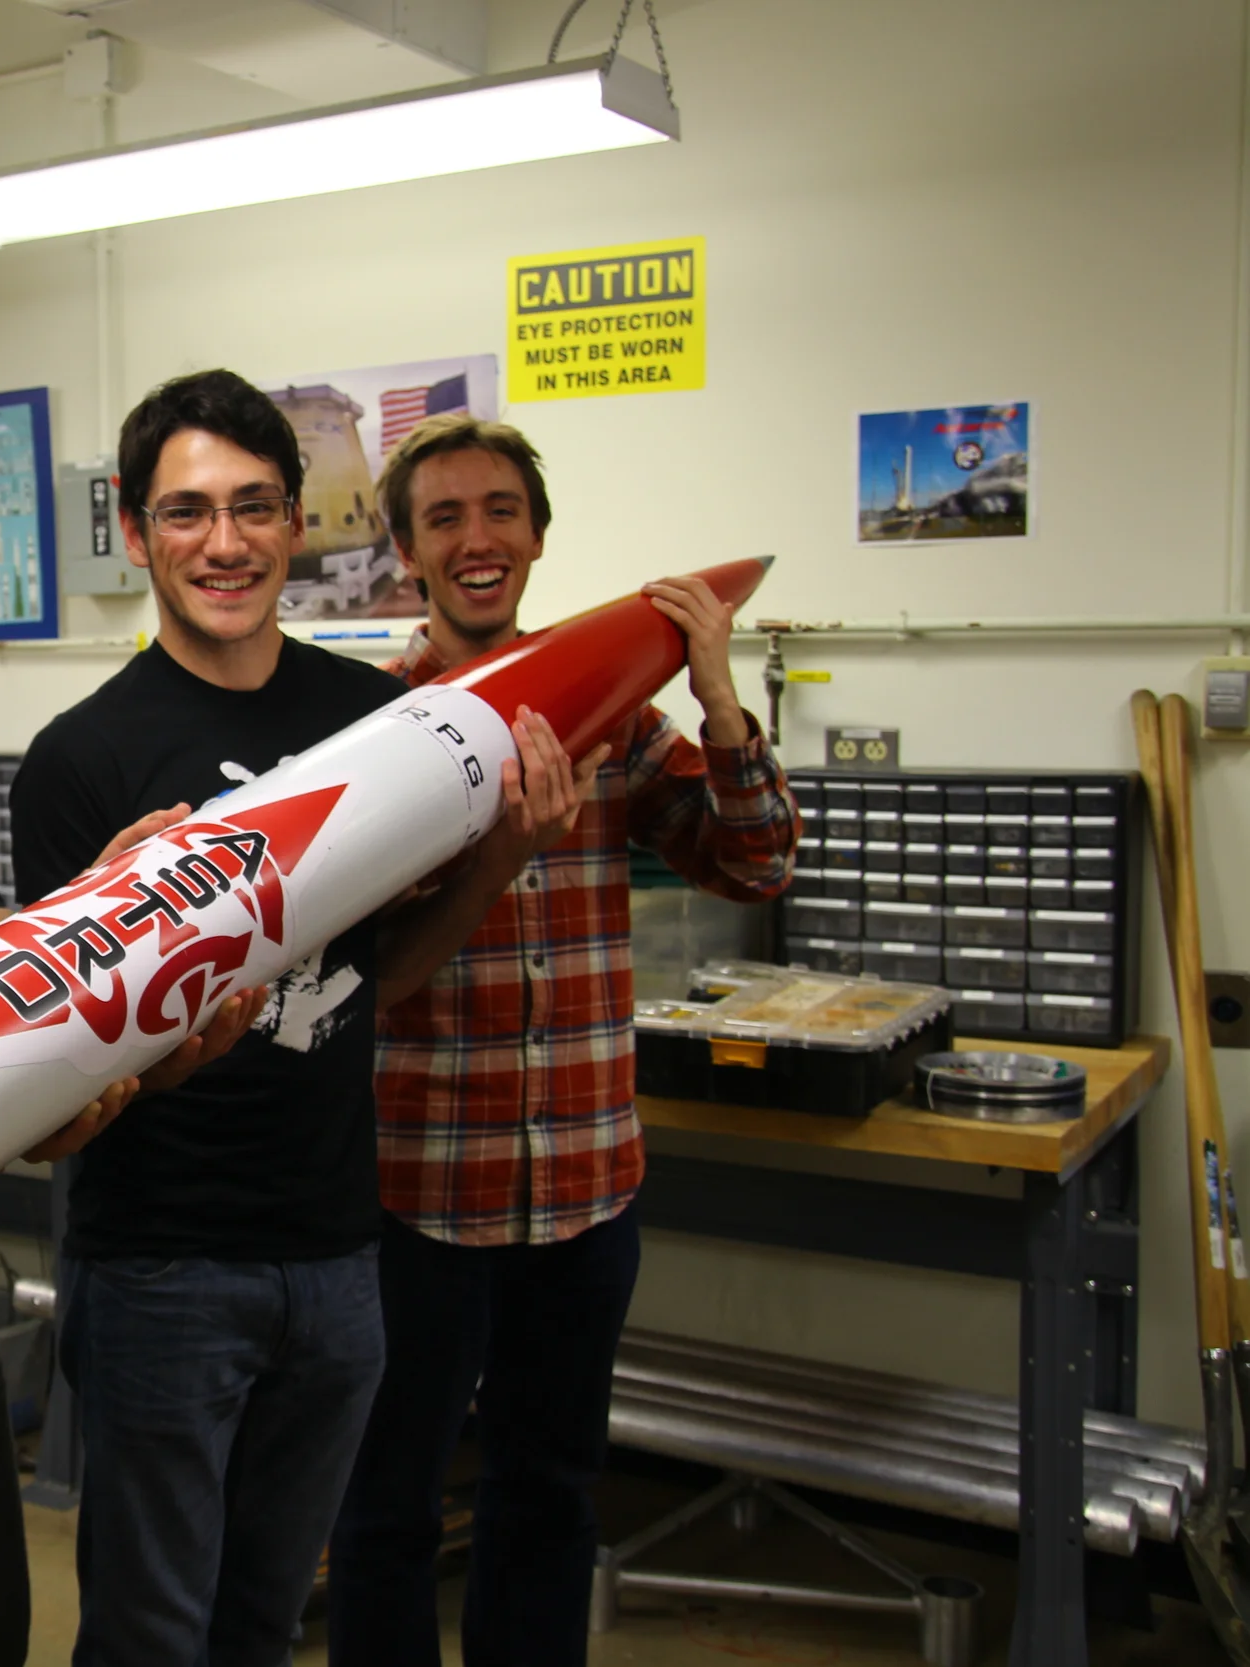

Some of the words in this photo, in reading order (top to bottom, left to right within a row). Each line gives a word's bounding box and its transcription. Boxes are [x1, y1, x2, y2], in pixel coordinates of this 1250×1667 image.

[518, 256, 691, 308] CAUTION
[517, 323, 552, 340] EYE
[561, 309, 693, 337] PROTECTION
[526, 346, 580, 366] MUST
[588, 343, 613, 361] BE
[621, 338, 684, 358] WORN
[537, 375, 556, 391] IN
[564, 370, 610, 388] THIS
[617, 366, 672, 385] AREA
